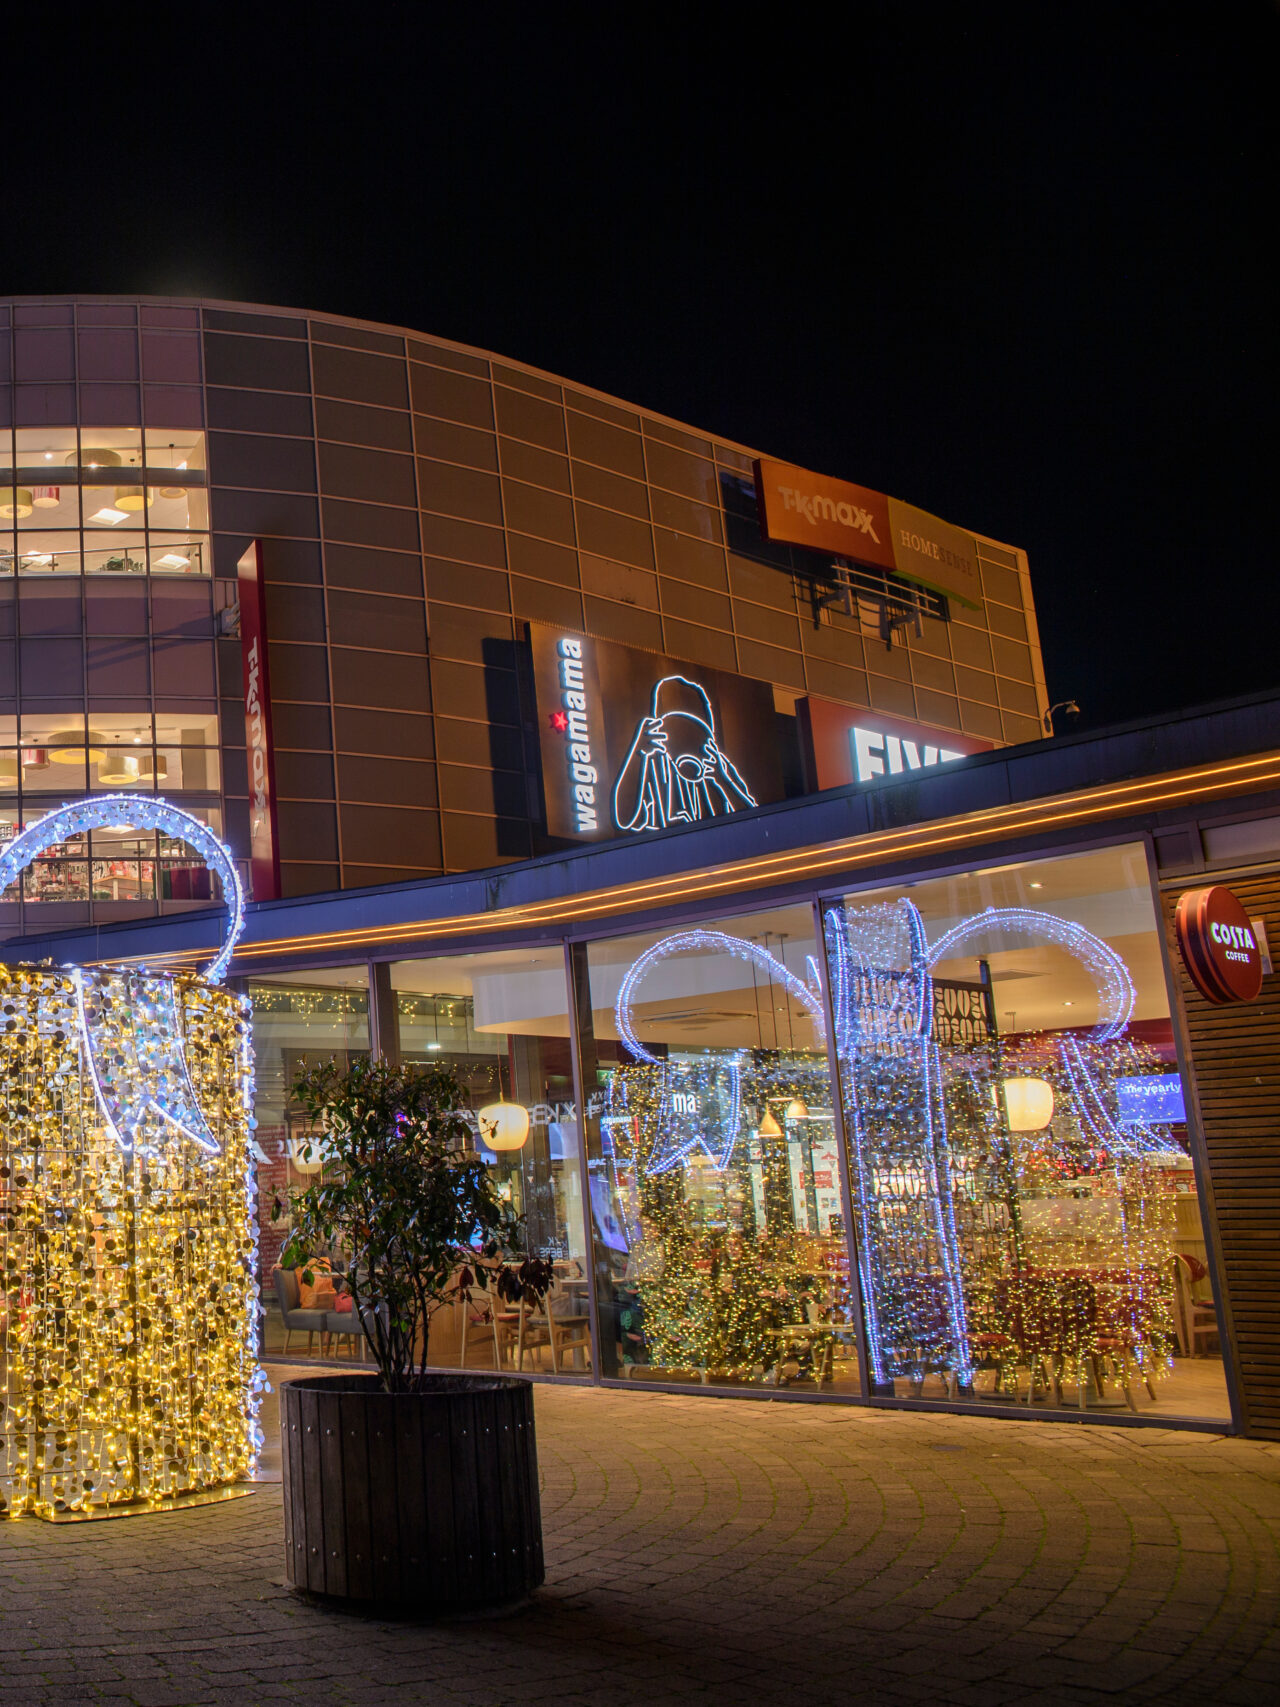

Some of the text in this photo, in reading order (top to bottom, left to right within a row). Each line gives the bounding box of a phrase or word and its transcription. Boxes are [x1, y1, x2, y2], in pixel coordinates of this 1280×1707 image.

[560, 637, 598, 833] wagamama
[1210, 921, 1256, 950] COSTA
[1225, 950, 1250, 963] COFFEE
[1144, 1082, 1182, 1097] yearly
